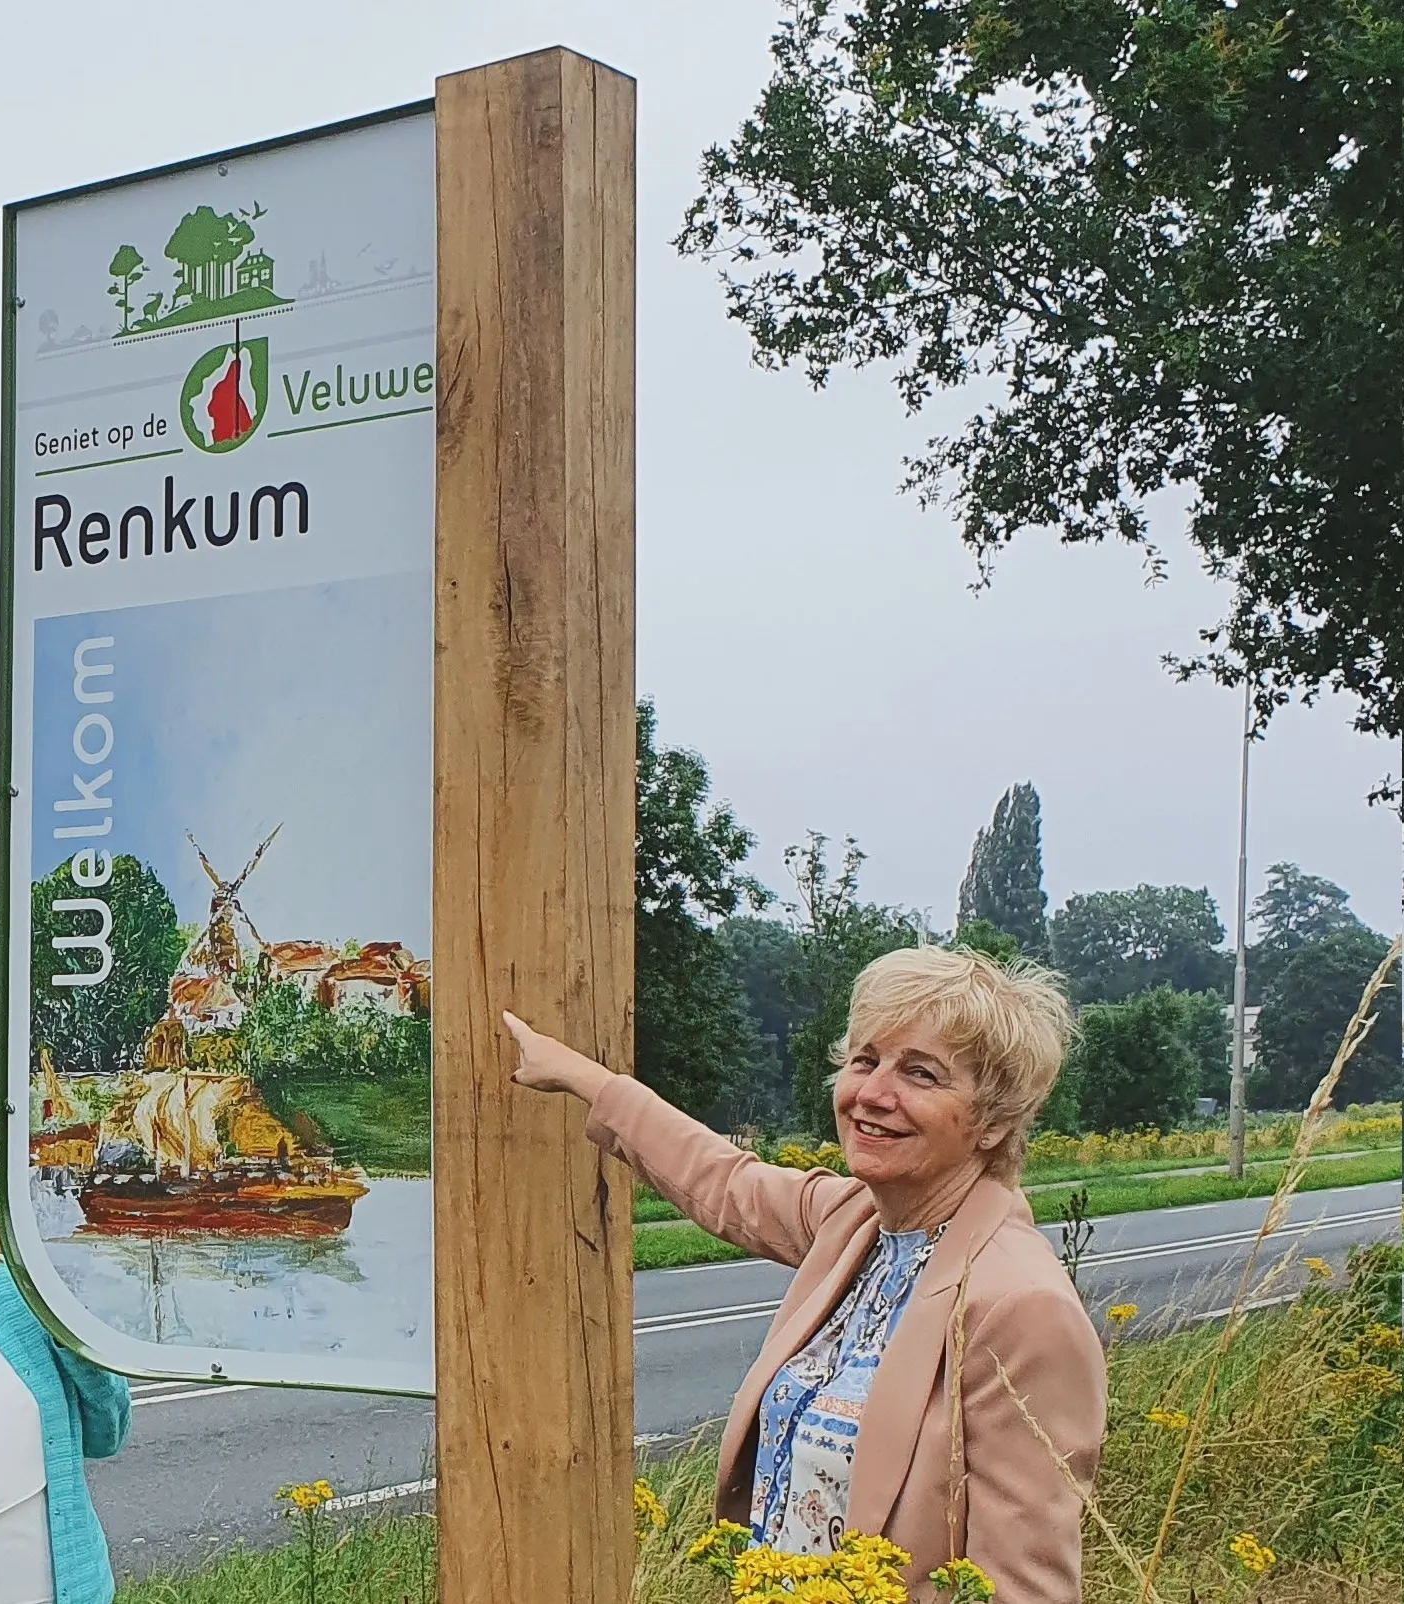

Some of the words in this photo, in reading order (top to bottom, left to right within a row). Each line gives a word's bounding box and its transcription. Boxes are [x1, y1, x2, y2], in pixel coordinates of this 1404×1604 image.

[35, 430, 99, 456] Geniet
[107, 422, 134, 450] op
[143, 413, 167, 437] de
[282, 362, 434, 415] Veluwe
[34, 475, 309, 571] Renkum
[51, 635, 115, 987] Welkom
